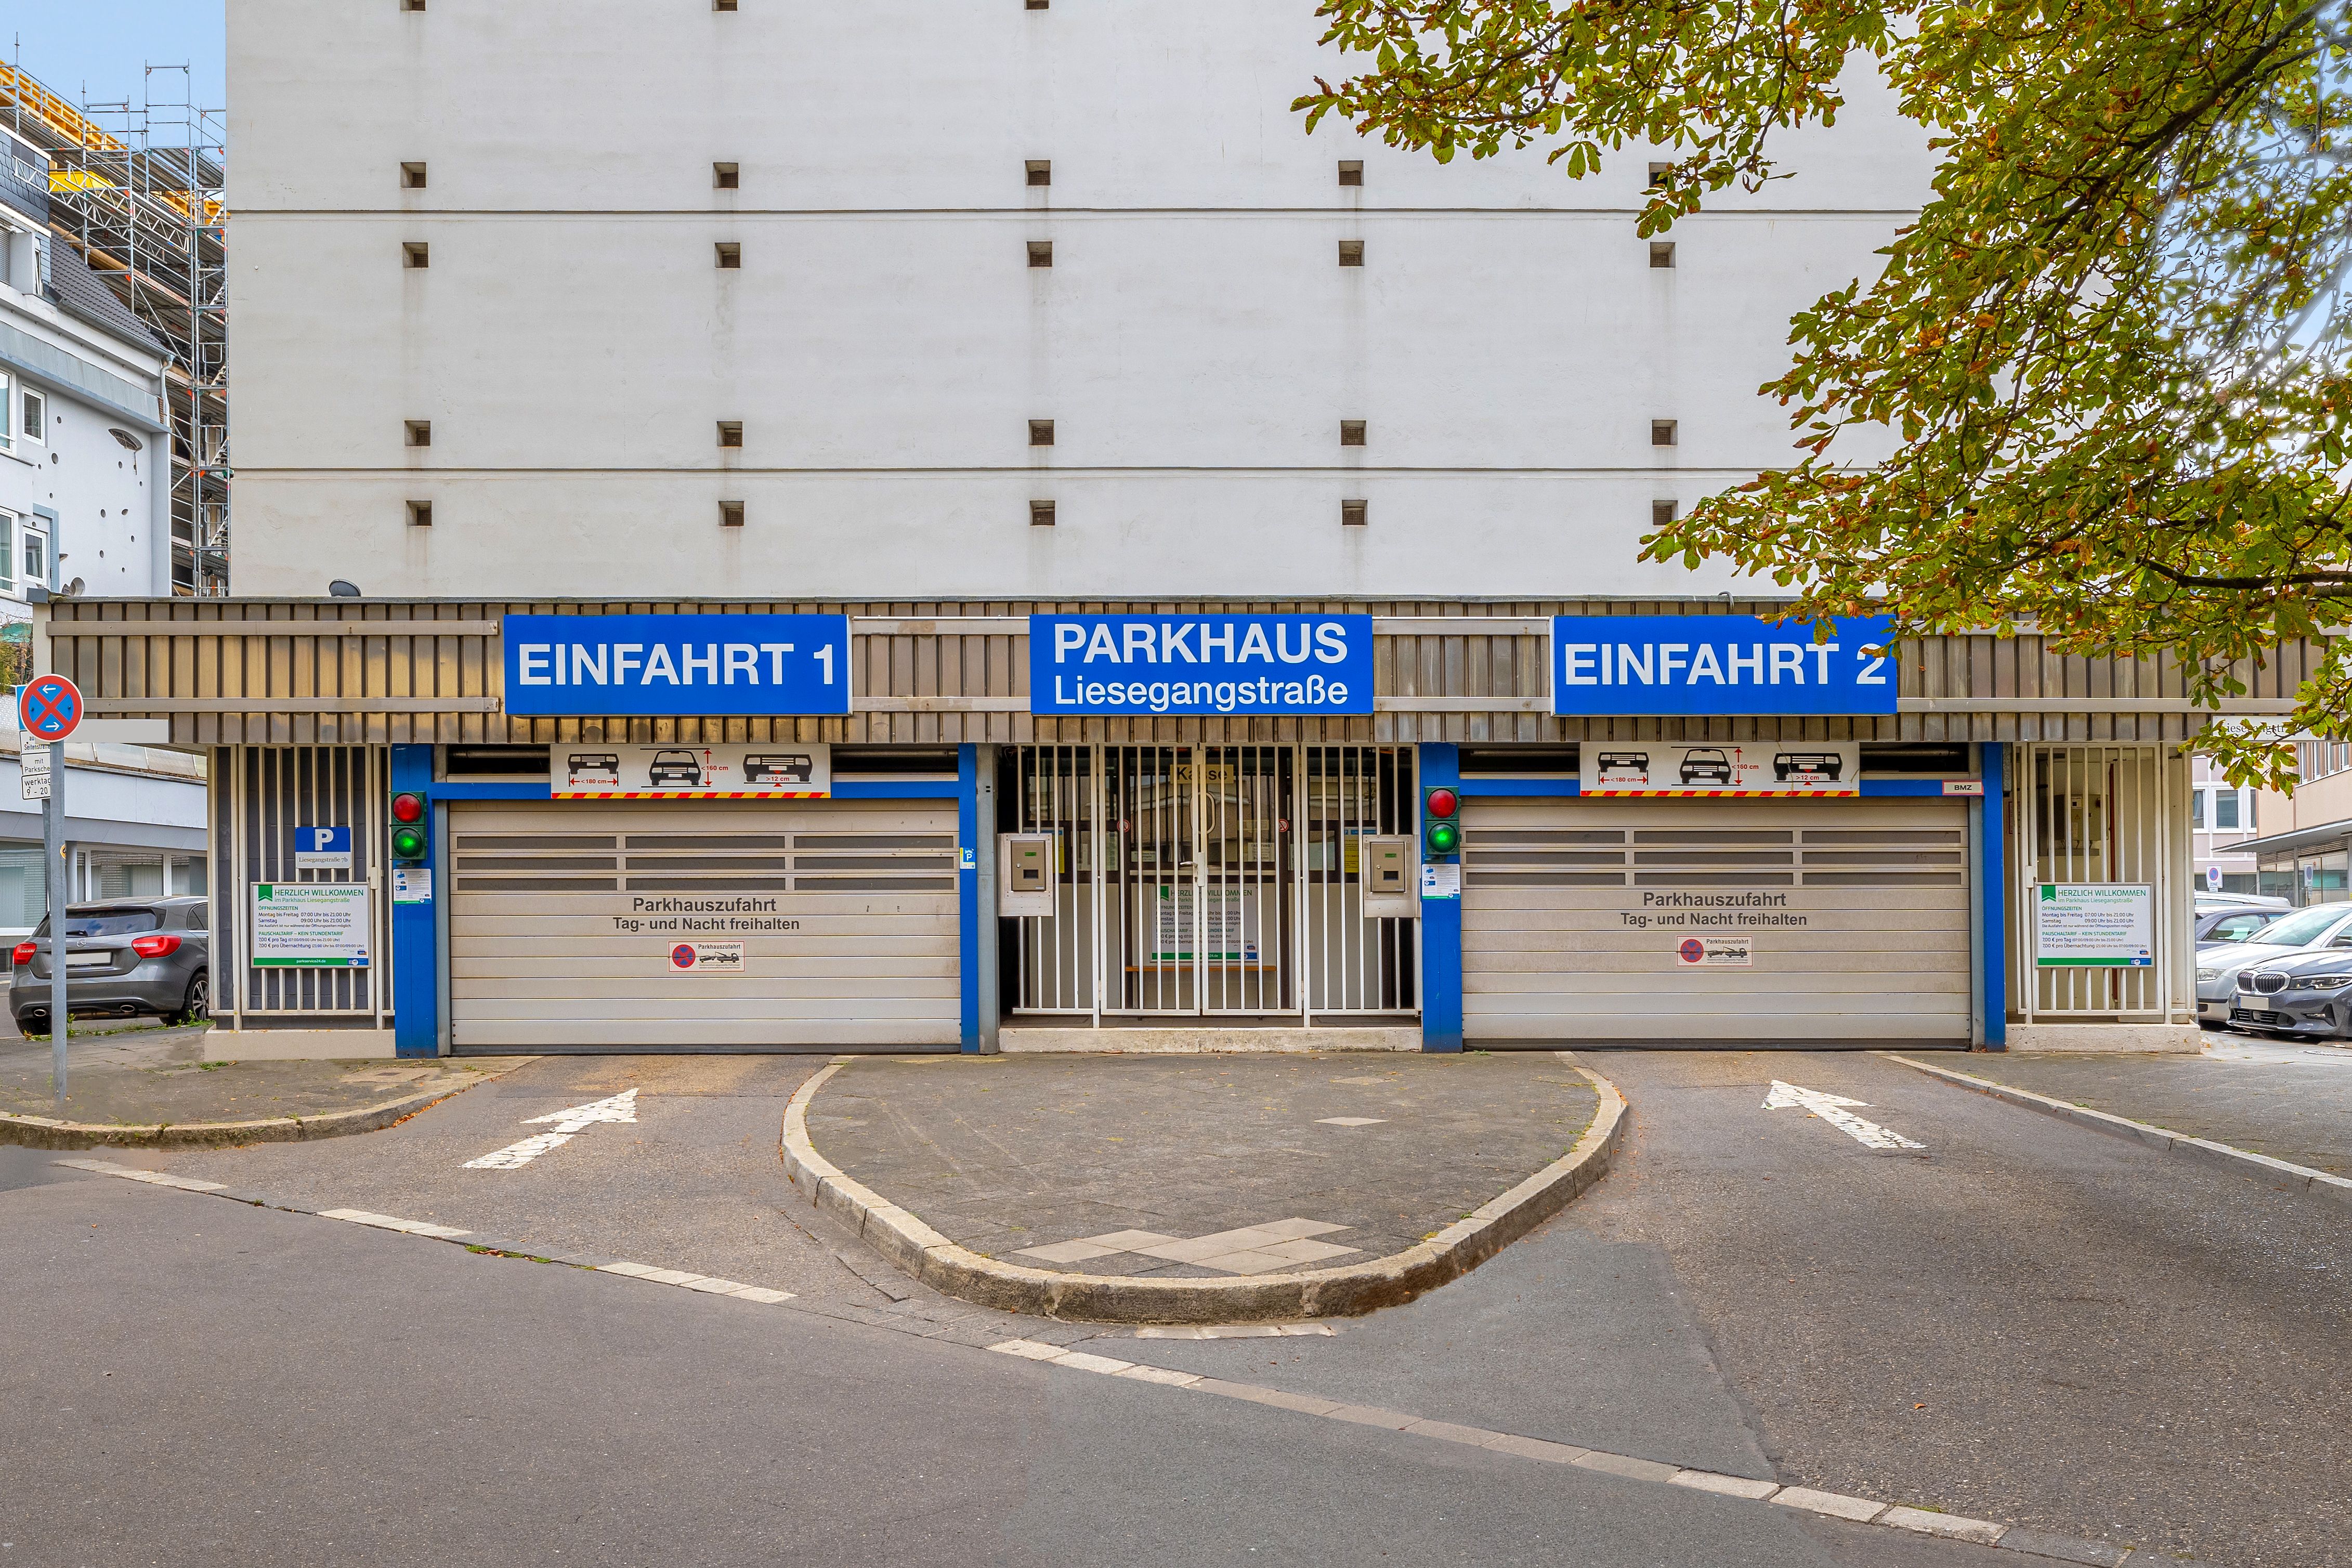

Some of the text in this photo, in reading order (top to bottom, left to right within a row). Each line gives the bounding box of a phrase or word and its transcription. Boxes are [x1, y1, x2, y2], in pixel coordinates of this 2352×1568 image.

[1054, 622, 1348, 663] PARKHAUS
[520, 644, 833, 685] EINFAHRT 1
[1565, 644, 1886, 685] EINFAHRT 2
[1055, 674, 1348, 712] Liesegangstraße
[24, 777, 50, 786] werktag
[1177, 767, 1227, 780] Kse
[315, 829, 334, 851] P
[633, 898, 776, 911] Parkhauszufahrt
[1644, 892, 1786, 906] Parkhauszufahrt
[613, 917, 800, 932] Tag- und Nacht freihalten
[1621, 912, 1807, 928] Tag- und Nacht freihalten
